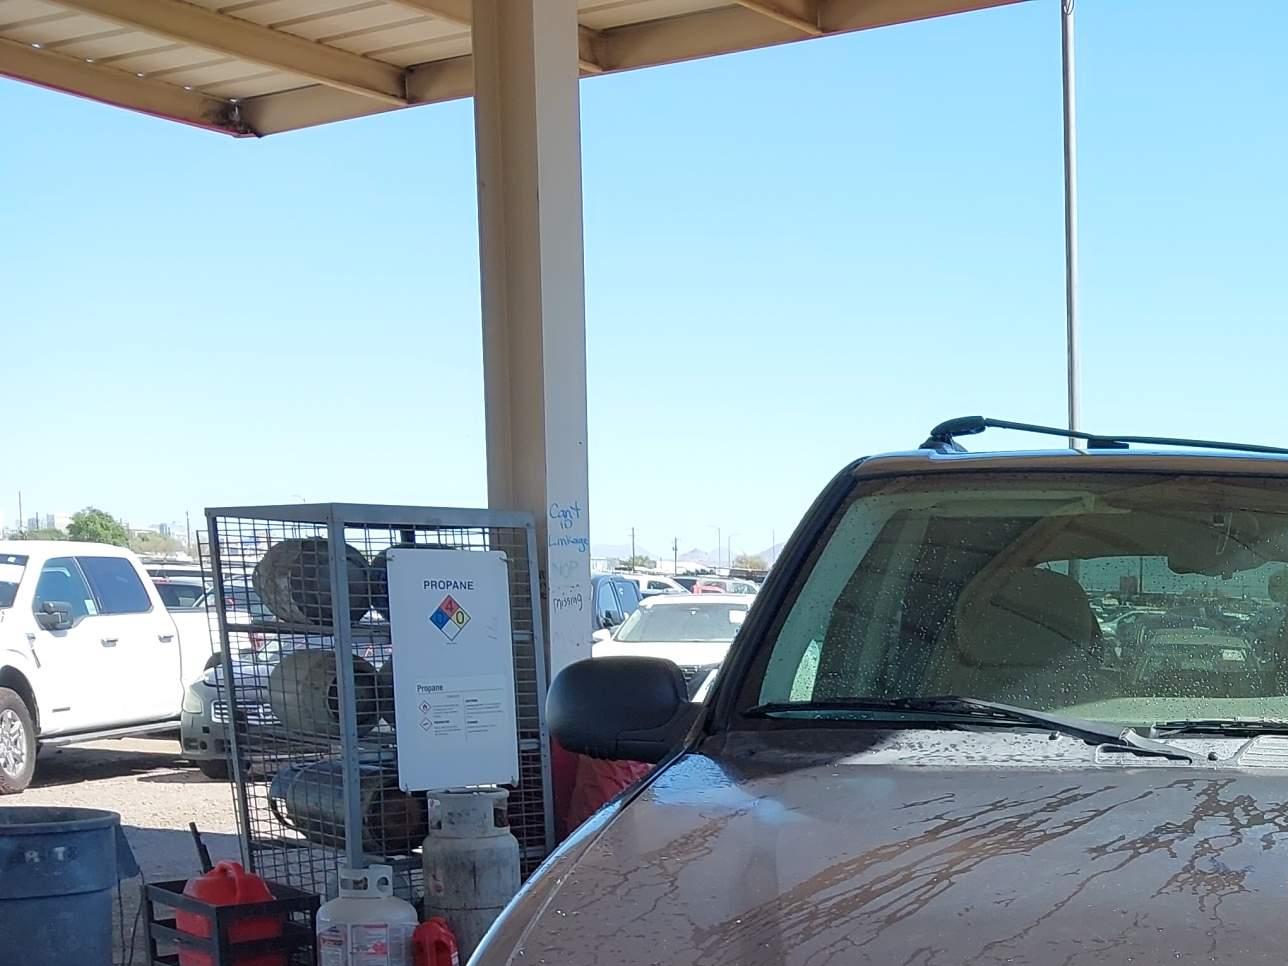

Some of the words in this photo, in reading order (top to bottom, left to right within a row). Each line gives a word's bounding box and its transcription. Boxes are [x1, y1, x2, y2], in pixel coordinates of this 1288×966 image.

[423, 580, 475, 591] PROPANE
[444, 599, 455, 613] 4
[553, 593, 583, 613] missing
[455, 610, 465, 625] 0
[417, 684, 444, 694] Propane
